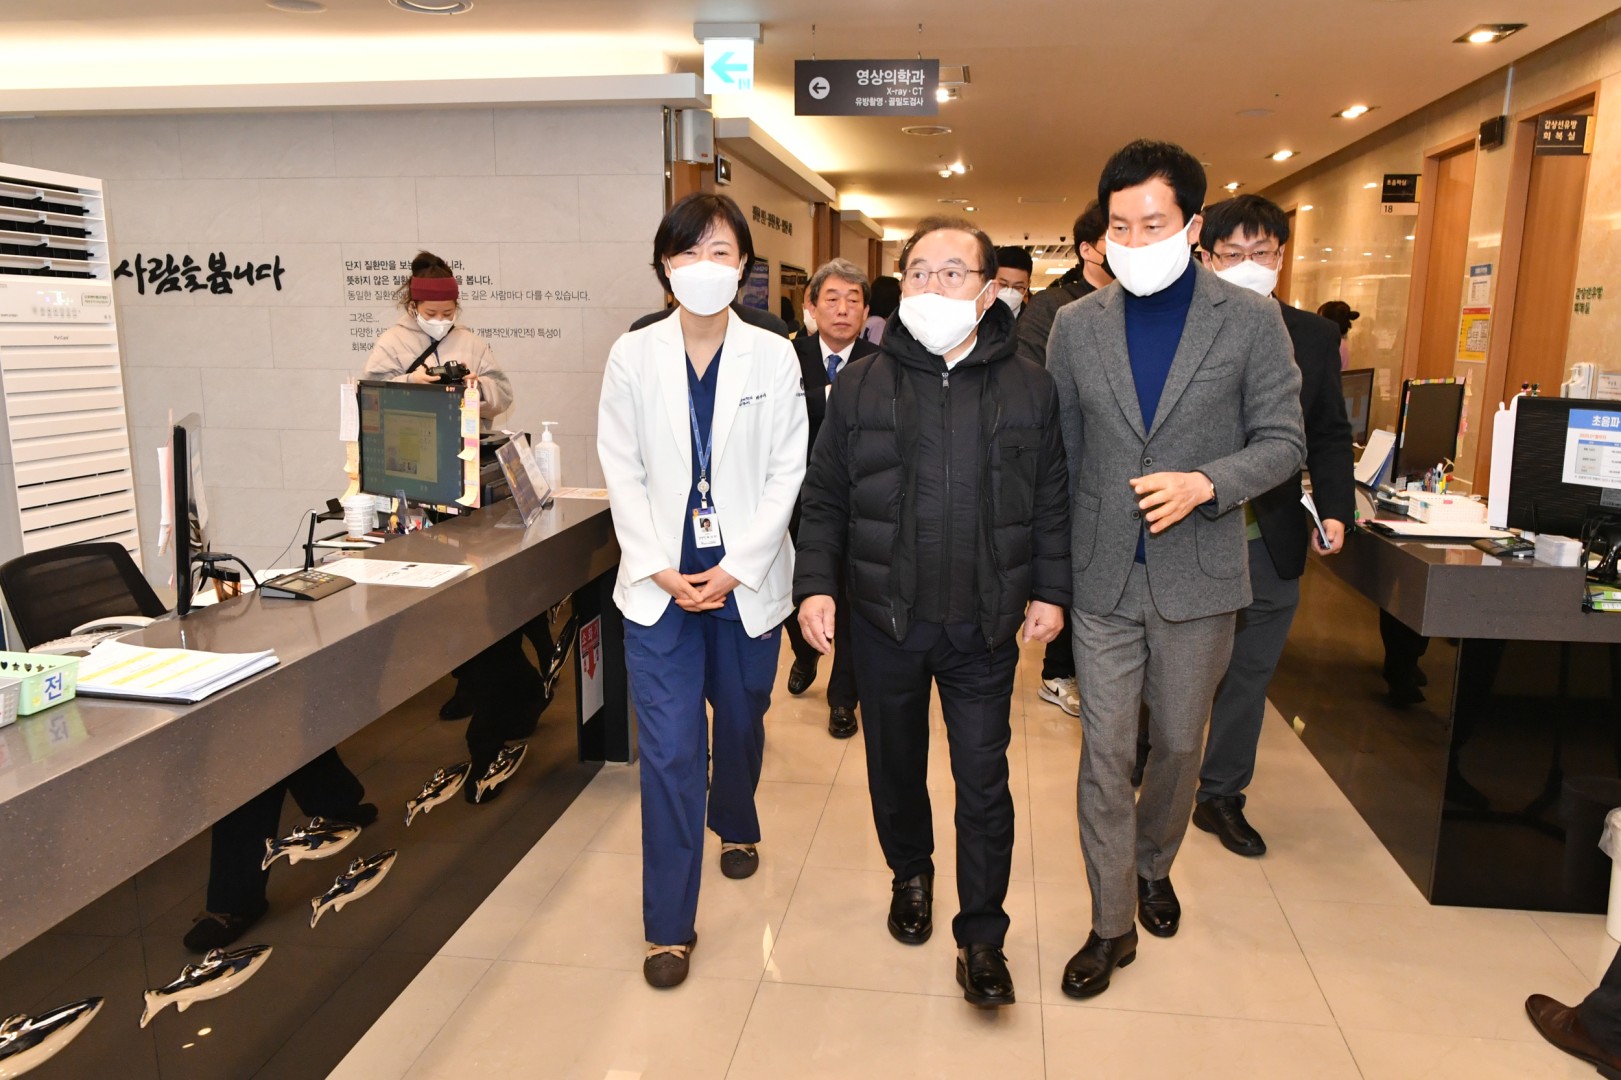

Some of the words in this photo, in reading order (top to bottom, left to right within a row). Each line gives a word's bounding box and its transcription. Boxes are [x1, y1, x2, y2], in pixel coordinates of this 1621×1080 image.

[856, 69, 925, 86] 영상의학과
[1544, 119, 1578, 130] 갑상선유방
[1384, 205, 1393, 213] 18
[345, 260, 362, 271] 단지
[364, 260, 397, 271] 질환만을
[346, 275, 371, 286] 뜻하지
[374, 275, 390, 286] 않은
[465, 275, 494, 286] 봅니다.
[347, 290, 372, 301] 동일한
[471, 290, 487, 301] 길은
[490, 290, 523, 301] 사람마다
[526, 290, 543, 301] 다를
[544, 290, 553, 301] 수
[554, 290, 591, 301] 있습니다.
[350, 328, 373, 338] 다양한
[477, 328, 536, 339] 개별적인(개인적)
[537, 328, 562, 339] 특성이
[1591, 414, 1621, 428] 초음파
[44, 672, 62, 701] 전
